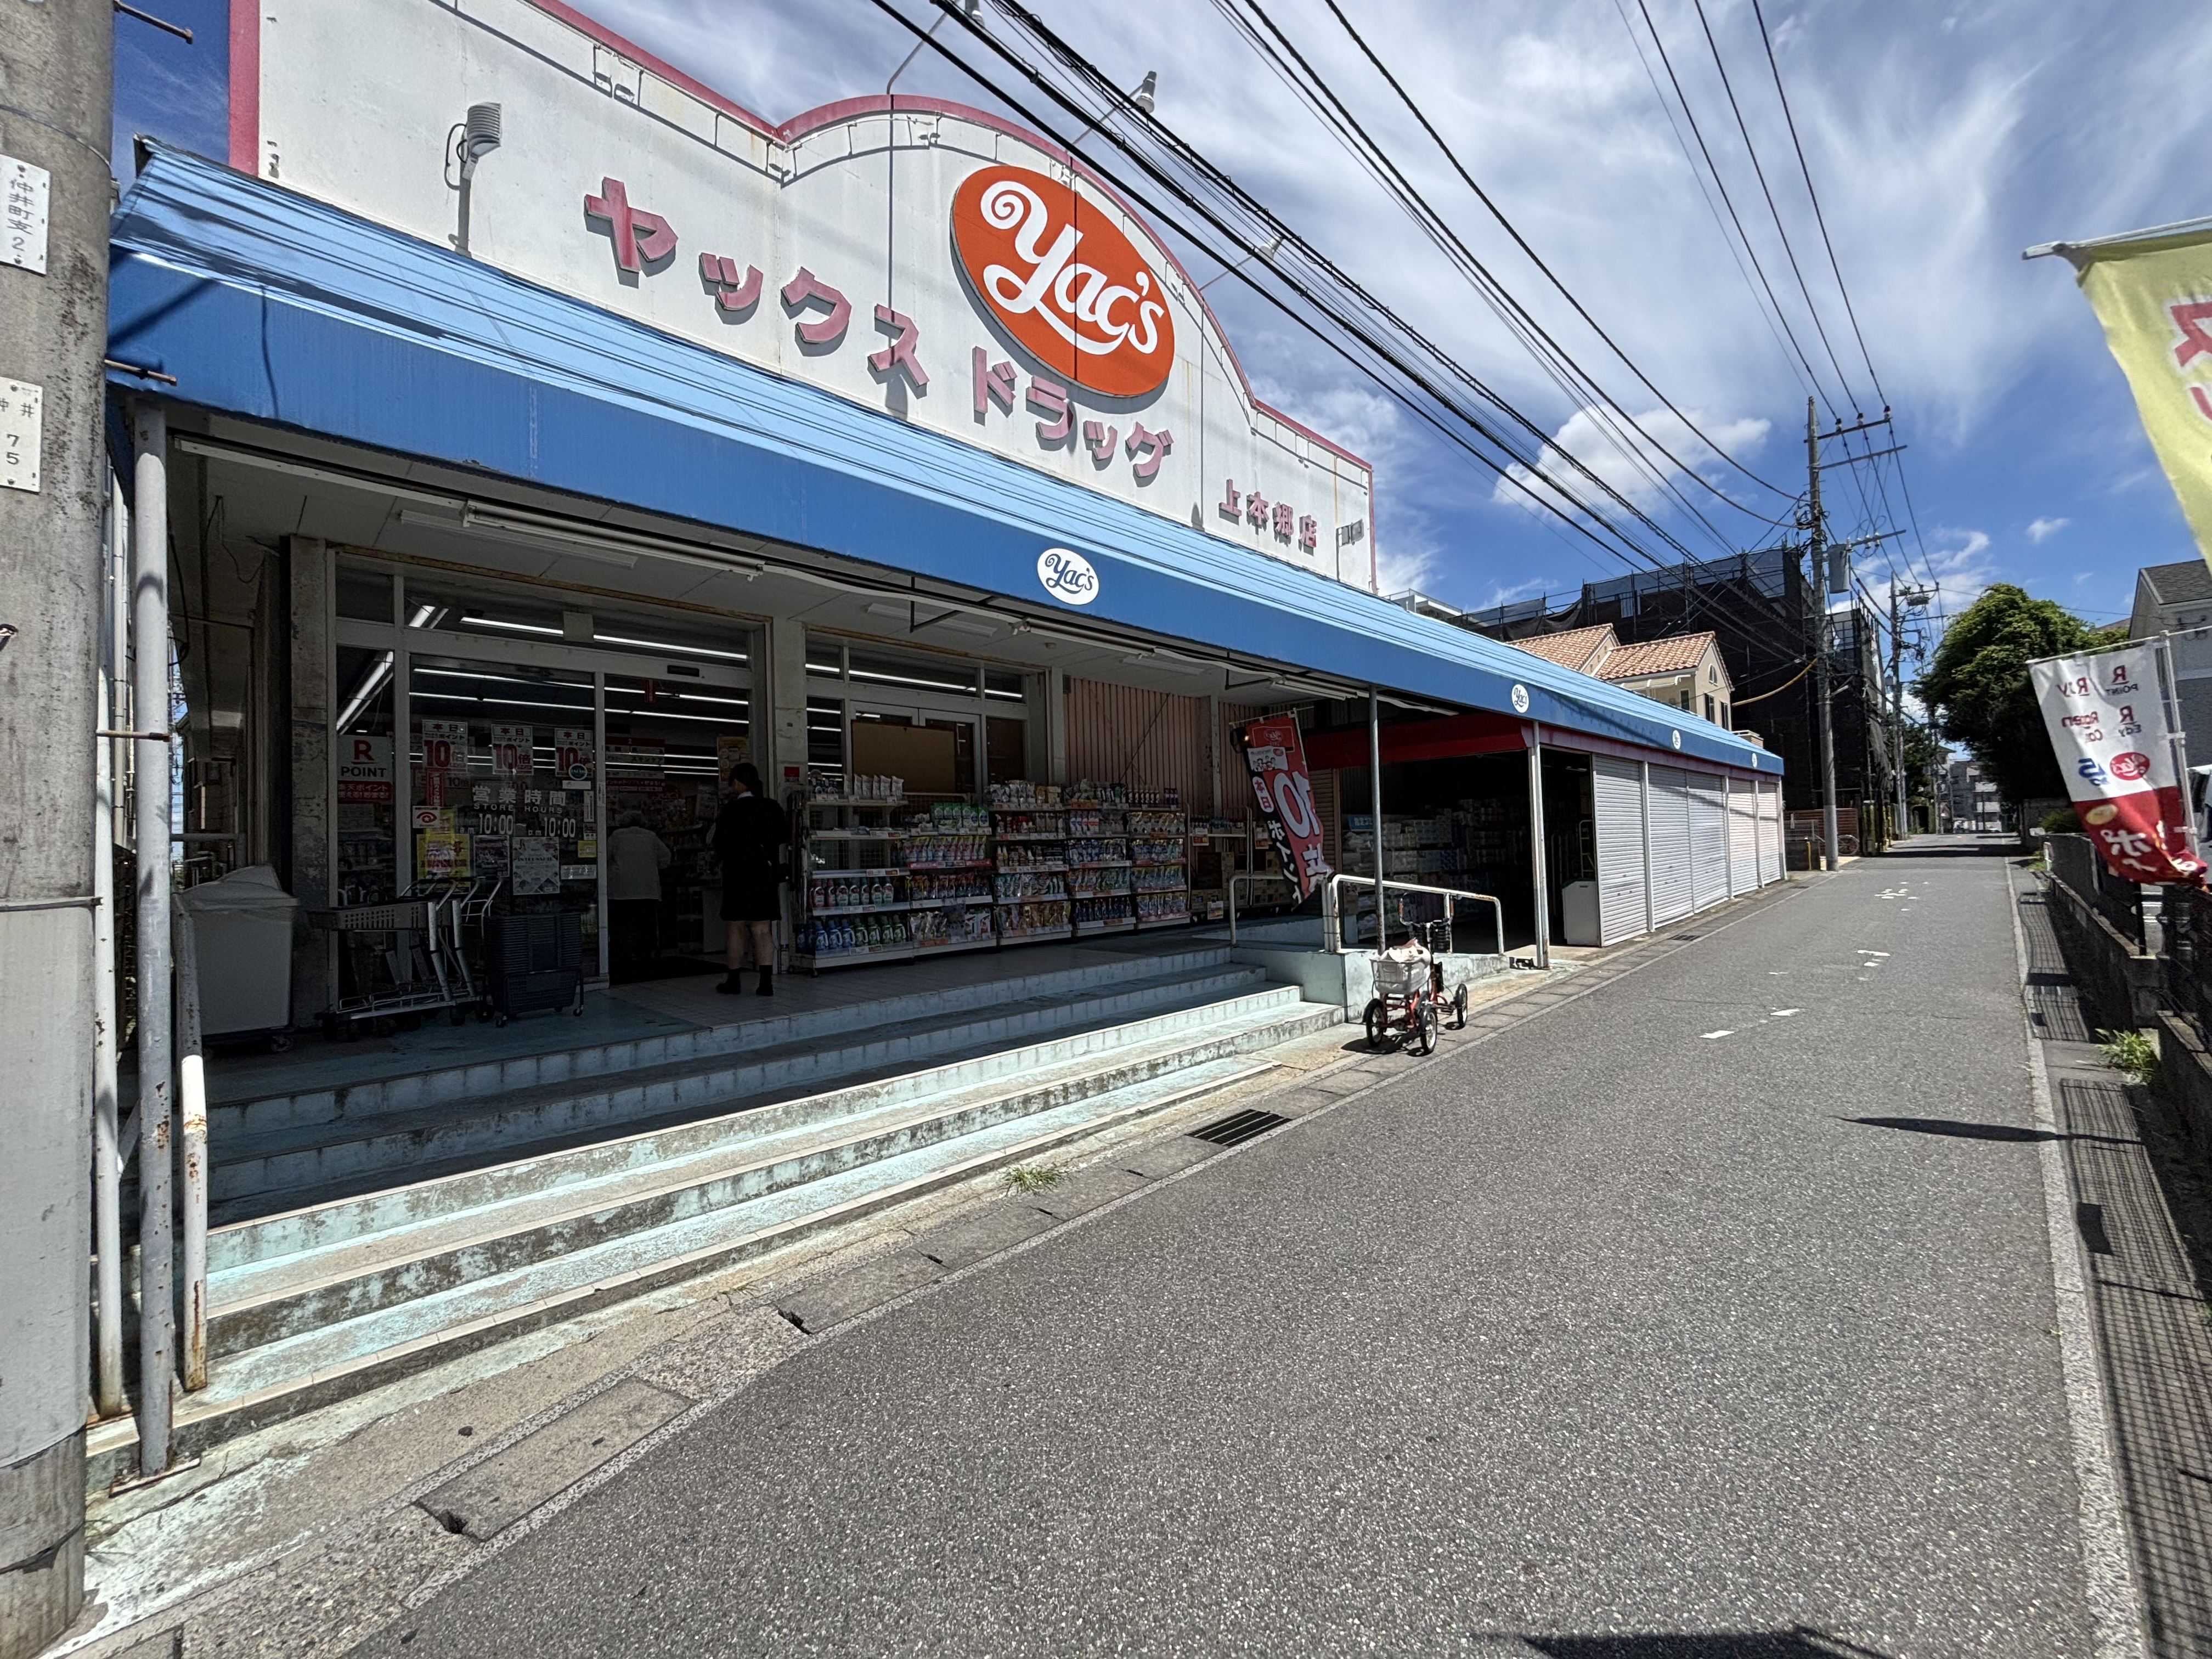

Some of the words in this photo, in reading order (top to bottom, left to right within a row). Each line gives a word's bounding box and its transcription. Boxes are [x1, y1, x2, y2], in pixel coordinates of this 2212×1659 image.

[980, 180, 1165, 355] Yac's
[584, 176, 930, 387] ヤックス
[972, 346, 1174, 477] ドラッグ
[1219, 478, 1317, 548] 上本郷店
[1045, 553, 1094, 594] Yac's
[433, 723, 458, 732] 本日
[500, 727, 524, 736] 本日
[354, 740, 374, 761] R
[341, 766, 387, 777] POINT
[472, 785, 566, 806] 営業時間
[473, 803, 515, 811] STORE
[479, 813, 514, 835] 10:00
[544, 817, 576, 838] 10:00
